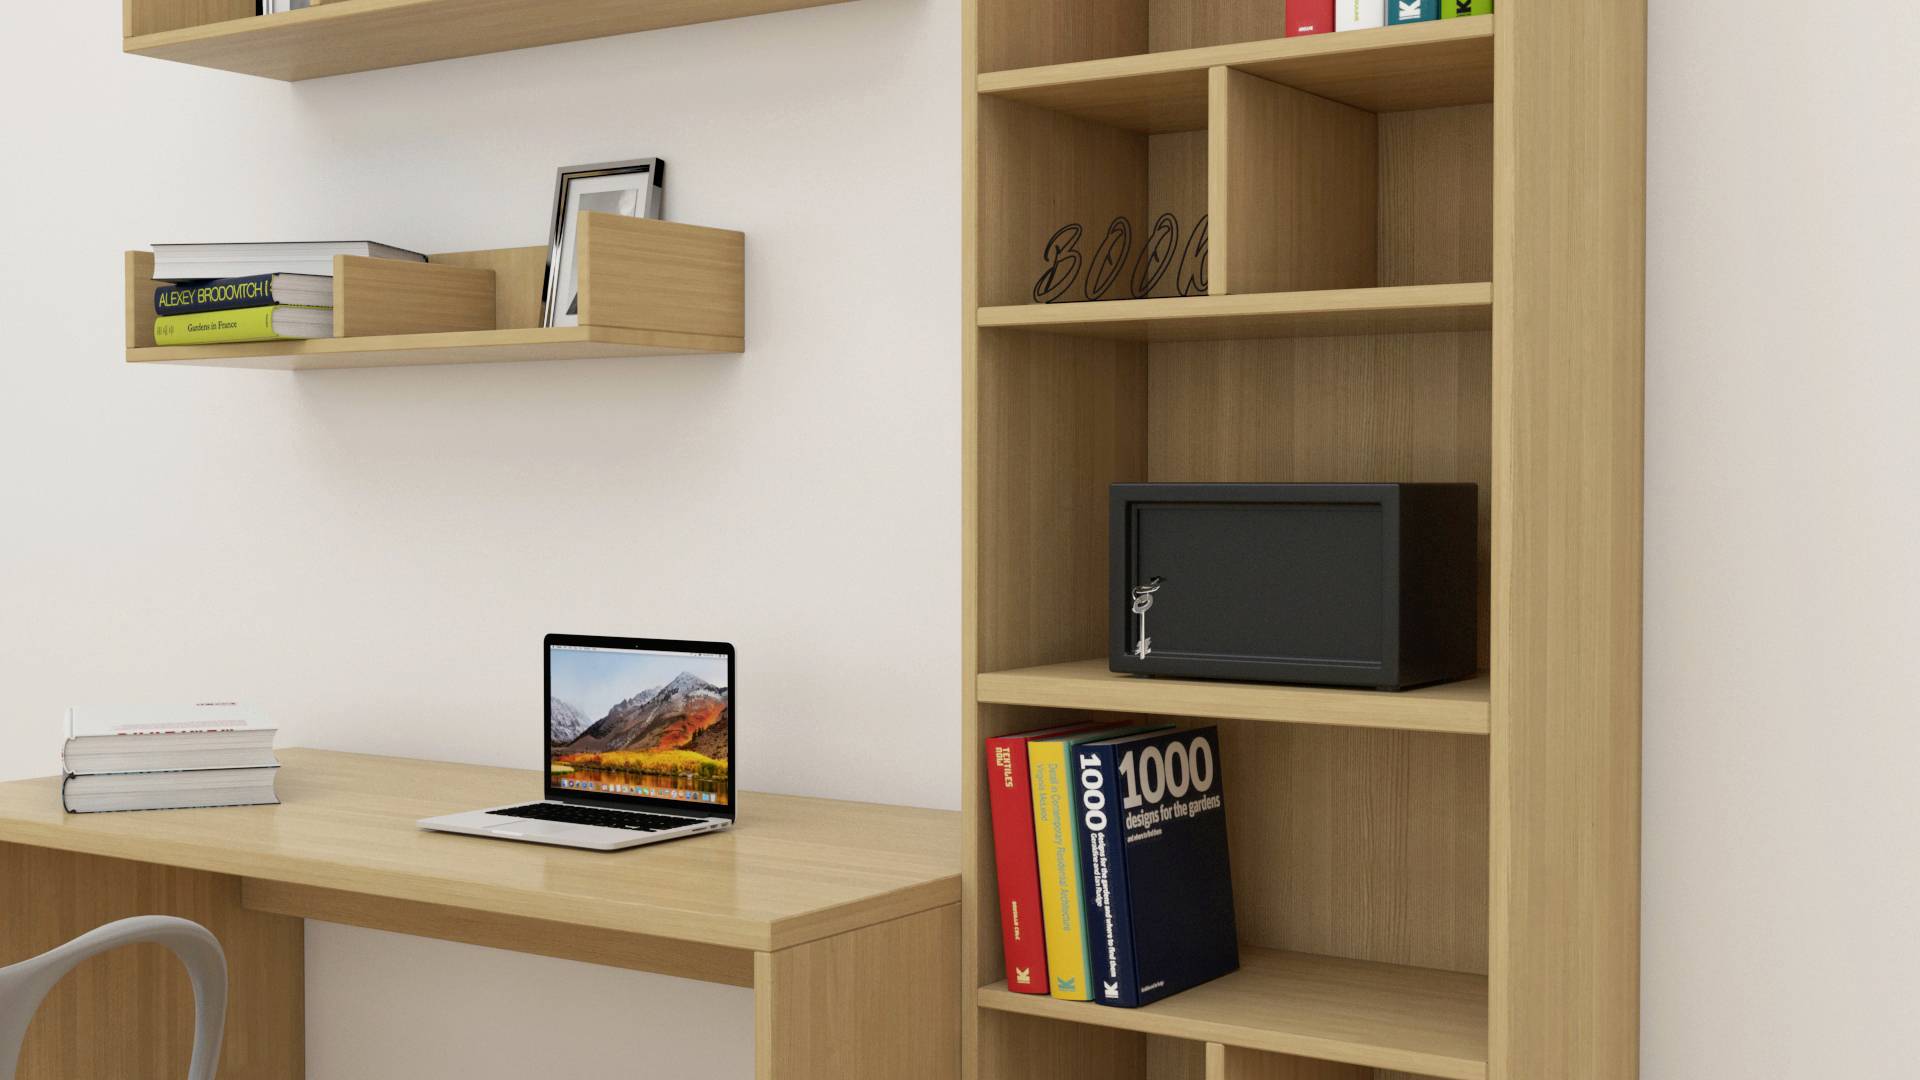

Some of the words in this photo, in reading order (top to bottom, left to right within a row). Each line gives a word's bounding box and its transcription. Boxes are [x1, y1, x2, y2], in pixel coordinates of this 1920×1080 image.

[159, 288, 196, 307] ALEXEY
[197, 281, 263, 304] BRODOVITCH
[187, 322, 210, 333] Gardens
[218, 320, 238, 330] France
[1118, 736, 1213, 809] 1000
[1080, 753, 1107, 831] 1000
[1125, 809, 1160, 829] designs
[1160, 803, 1173, 822] for
[1173, 801, 1188, 818] the
[1188, 794, 1220, 817] gardens
[1093, 863, 1101, 875] and
[1097, 832, 1106, 857] designs
[1104, 905, 1112, 918] and
